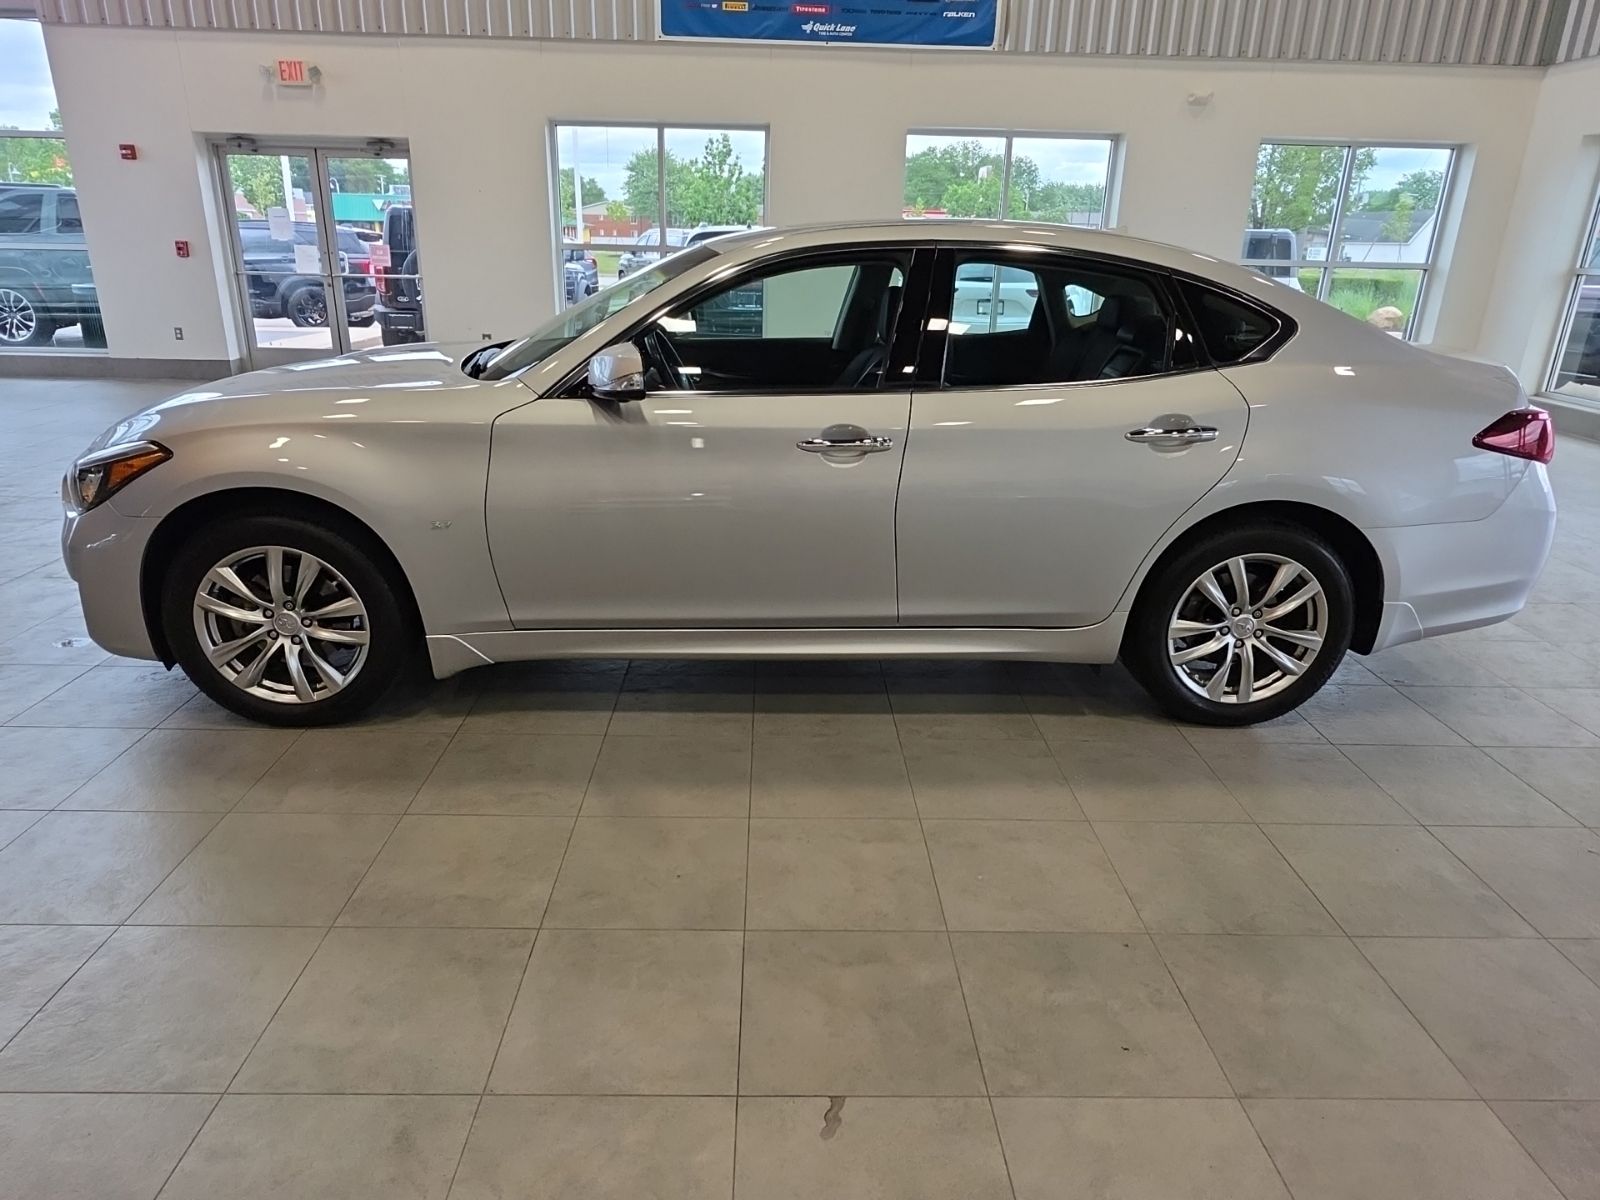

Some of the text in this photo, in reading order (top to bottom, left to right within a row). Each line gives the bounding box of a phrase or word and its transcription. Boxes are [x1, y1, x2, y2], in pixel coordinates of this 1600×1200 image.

[813, 23, 856, 32] Quick Lane
[278, 60, 304, 81] EXIT
